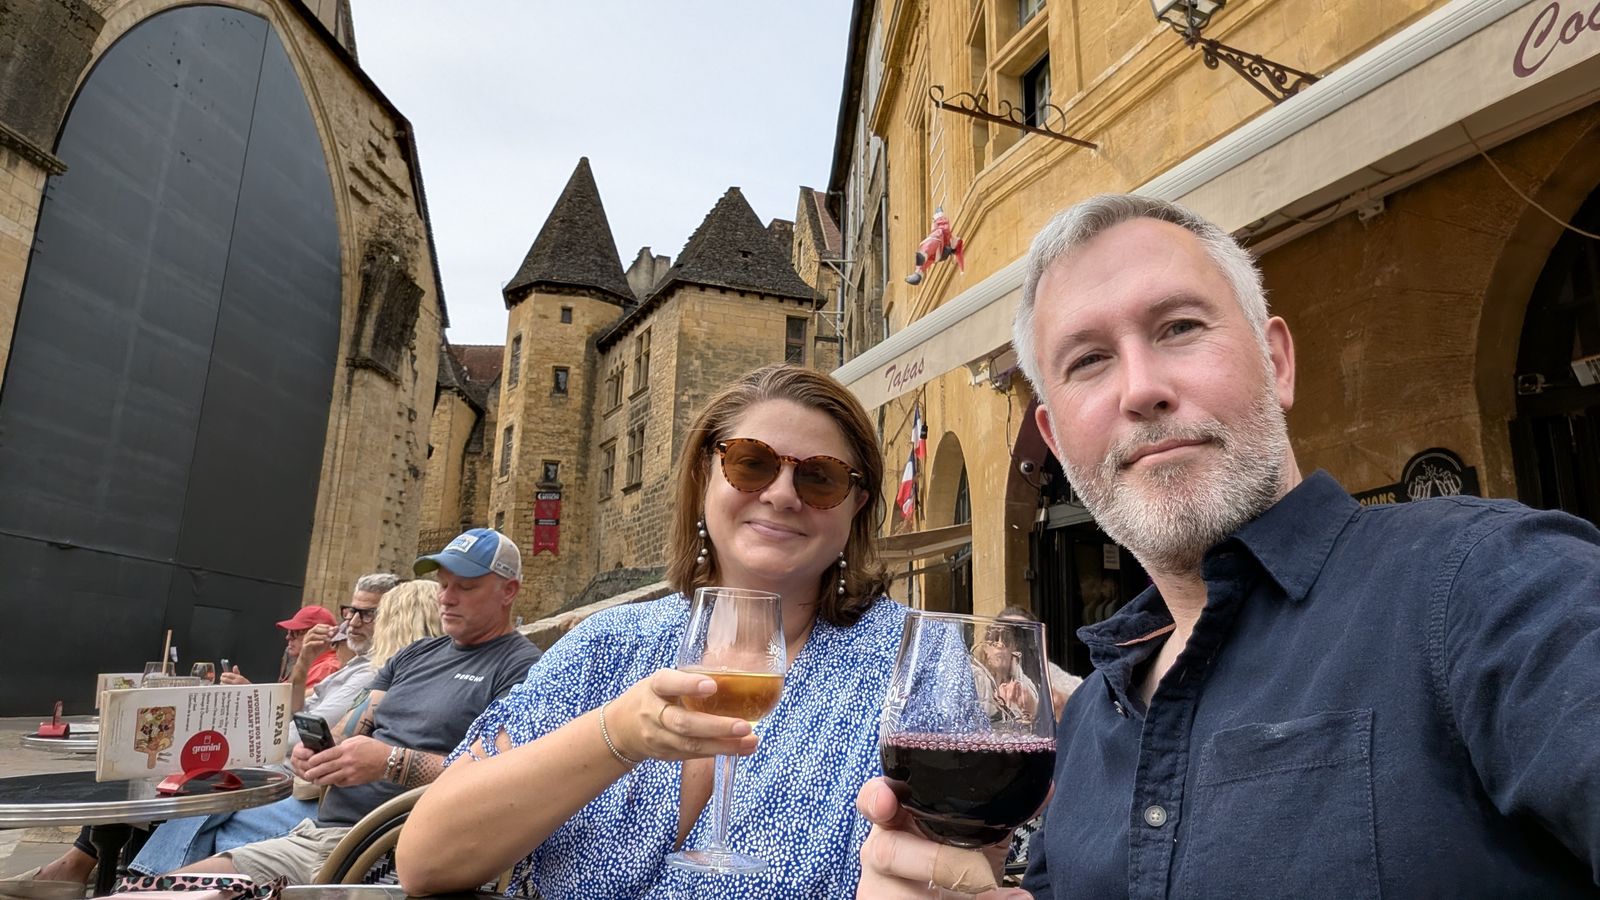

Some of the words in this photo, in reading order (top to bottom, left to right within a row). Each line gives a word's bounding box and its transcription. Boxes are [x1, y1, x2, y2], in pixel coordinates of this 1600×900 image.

[885, 357, 925, 392] Tapas
[253, 689, 261, 725] SAVOUREZ
[273, 704, 284, 745] TAPAS
[192, 743, 221, 754] granini
